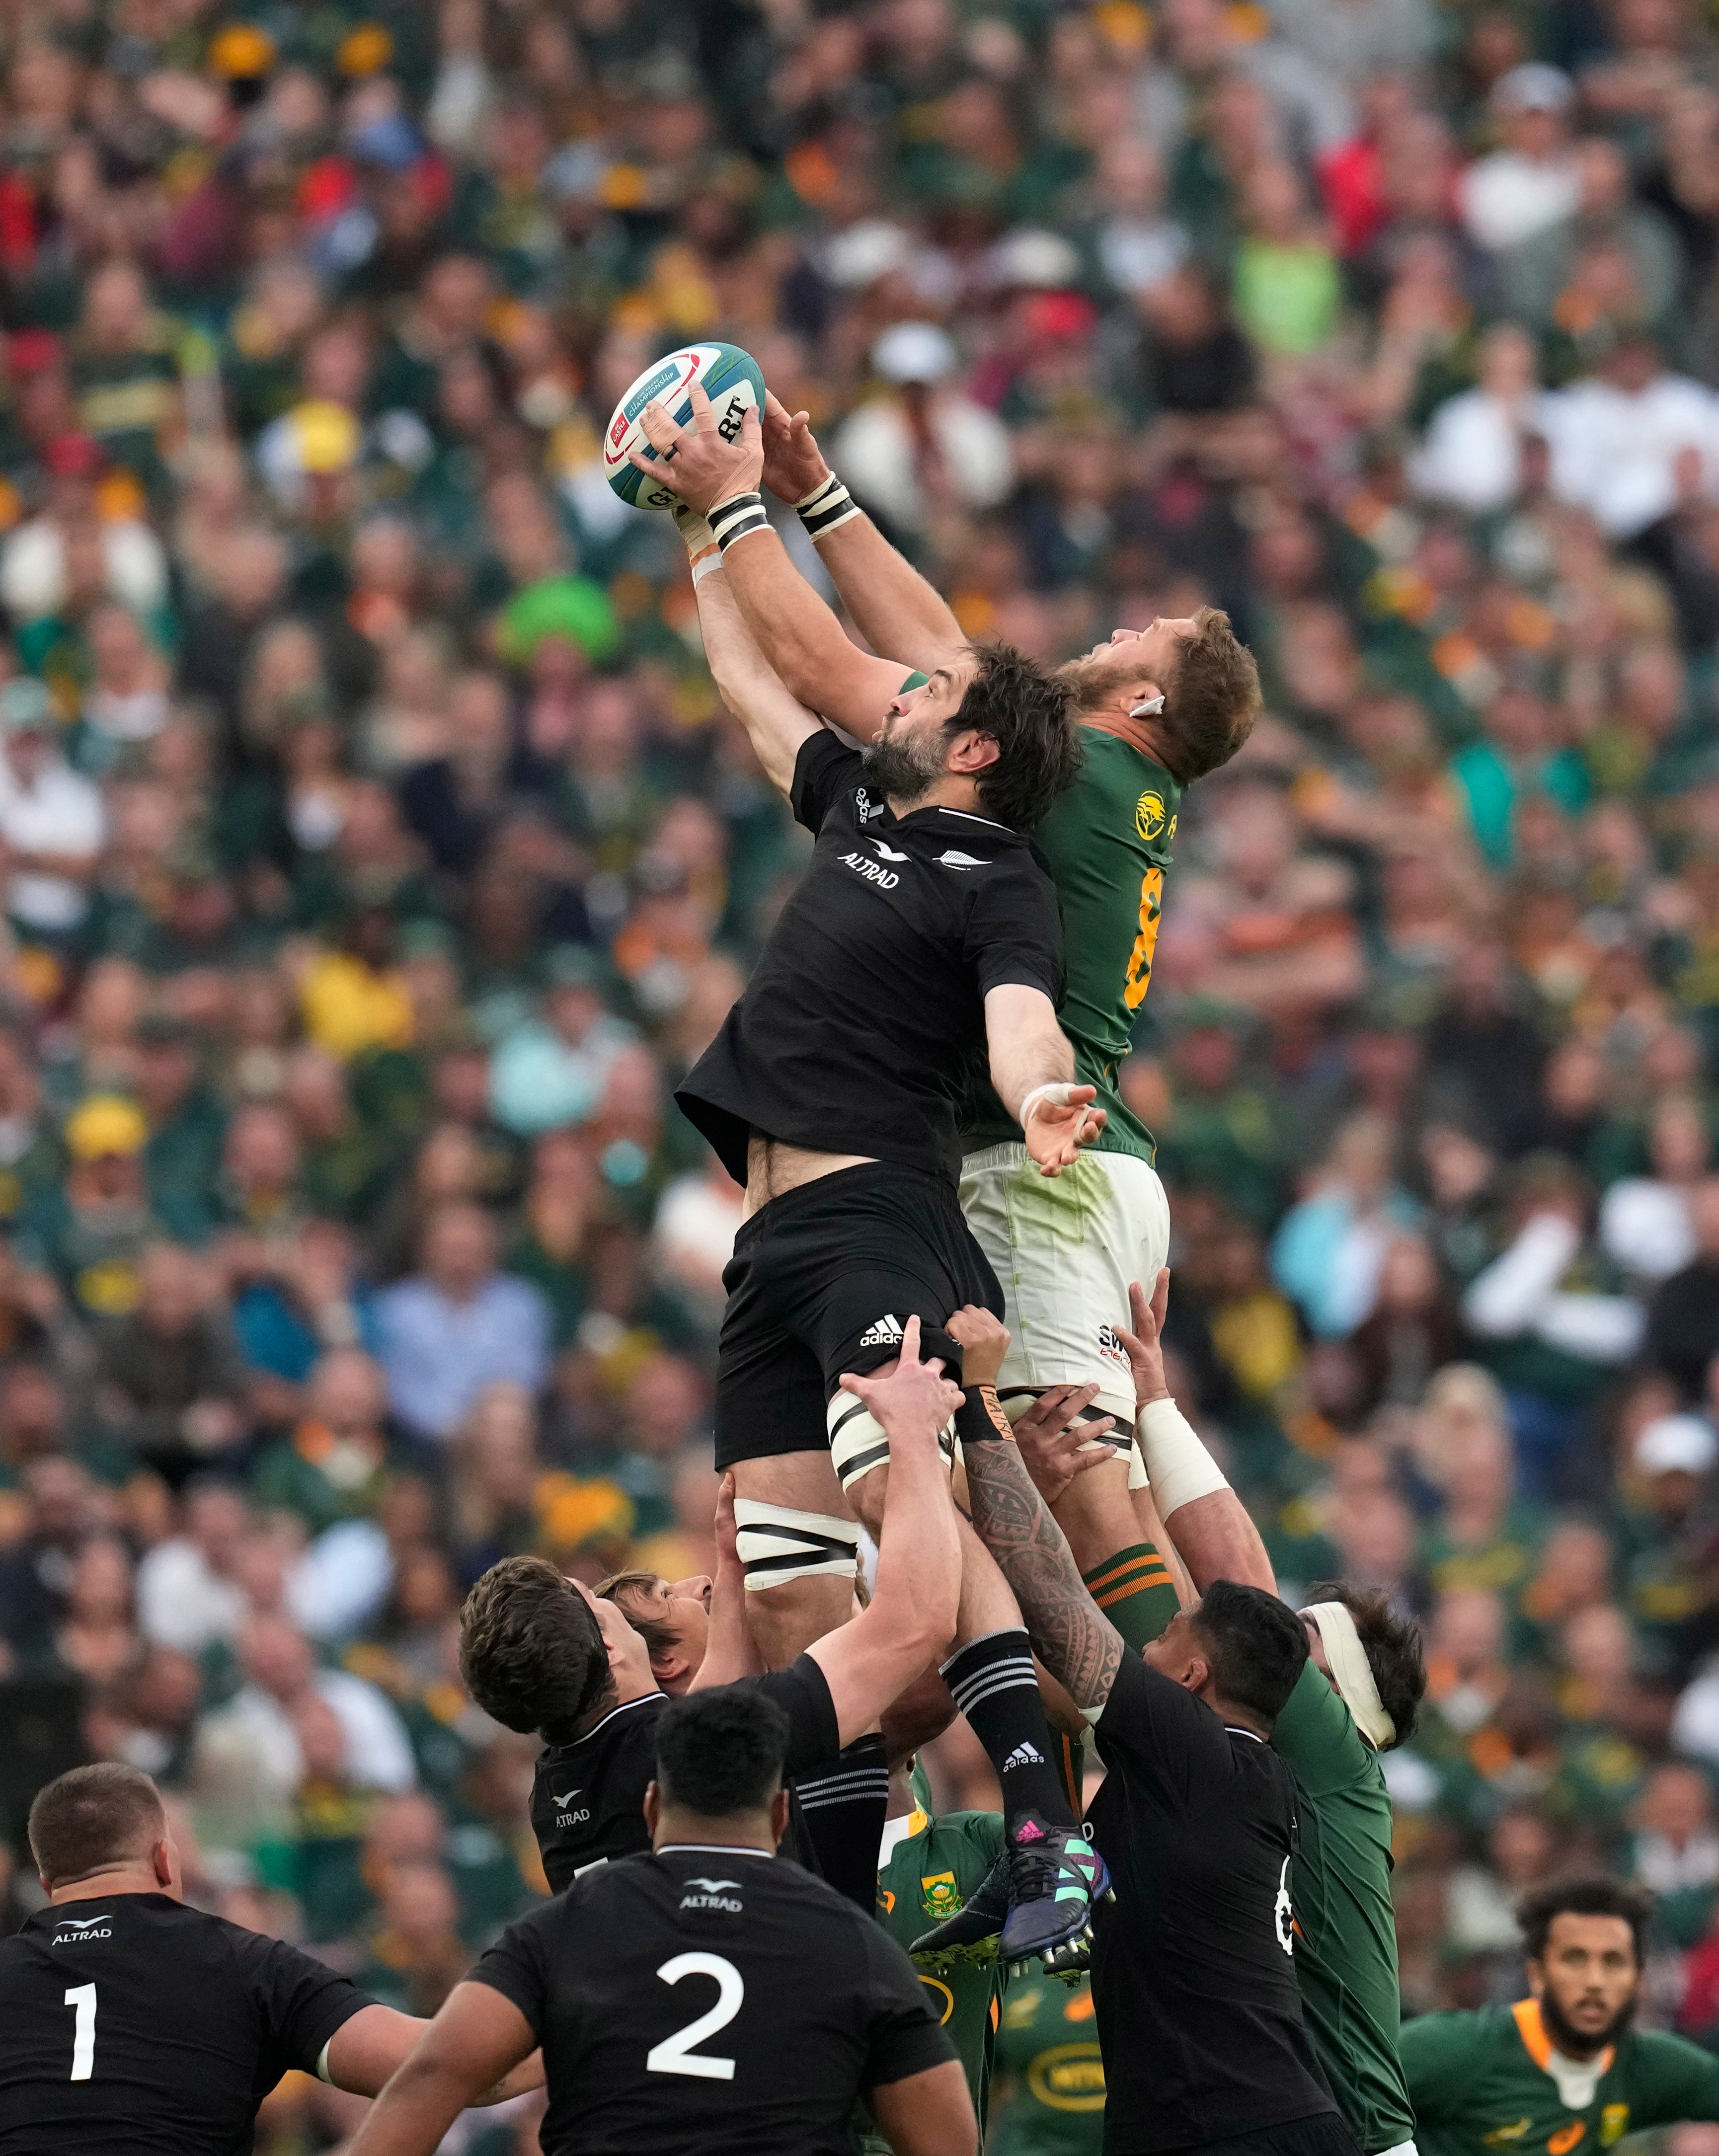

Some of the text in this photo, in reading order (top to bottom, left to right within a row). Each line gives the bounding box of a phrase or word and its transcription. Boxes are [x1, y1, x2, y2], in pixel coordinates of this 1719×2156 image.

[629, 372, 674, 416] CHAMPIONSHIP
[613, 420, 627, 442] CASTLE
[837, 852, 899, 889] ALTRAD
[1003, 1755, 1044, 1772] adidas
[556, 1809, 590, 1828] ALTRAD
[679, 1894, 743, 1913] ALTRAD
[51, 1928, 112, 1946] ALTRAD
[646, 1951, 745, 2080] 2
[64, 1982, 97, 2080] 1
